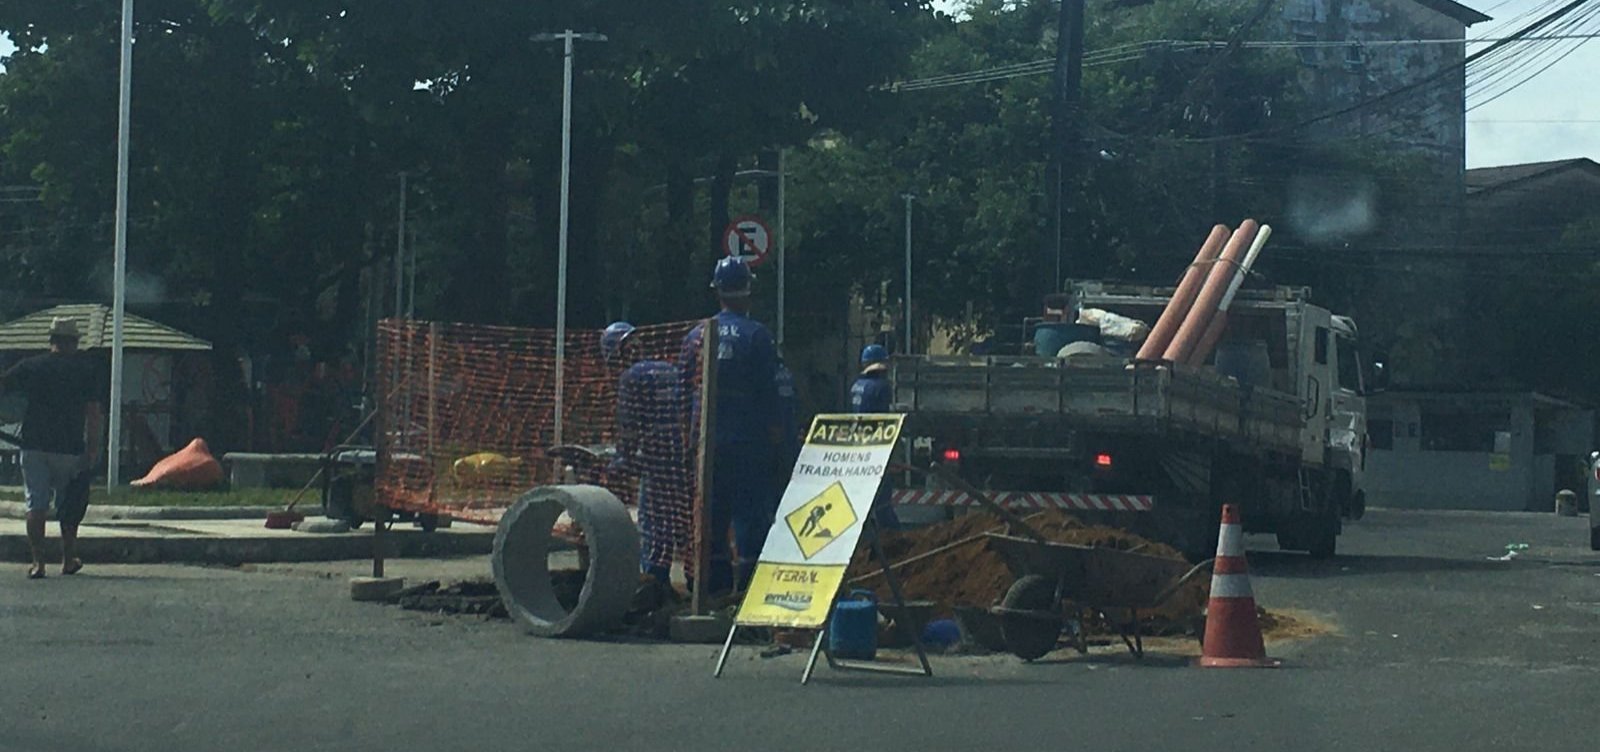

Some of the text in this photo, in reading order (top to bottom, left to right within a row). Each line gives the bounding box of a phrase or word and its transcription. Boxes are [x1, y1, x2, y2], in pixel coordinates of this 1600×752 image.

[738, 227, 756, 256] E
[814, 421, 897, 445] ATENÇÃO
[823, 452, 871, 463] HOMENS
[798, 464, 883, 477] TRABALHANDO
